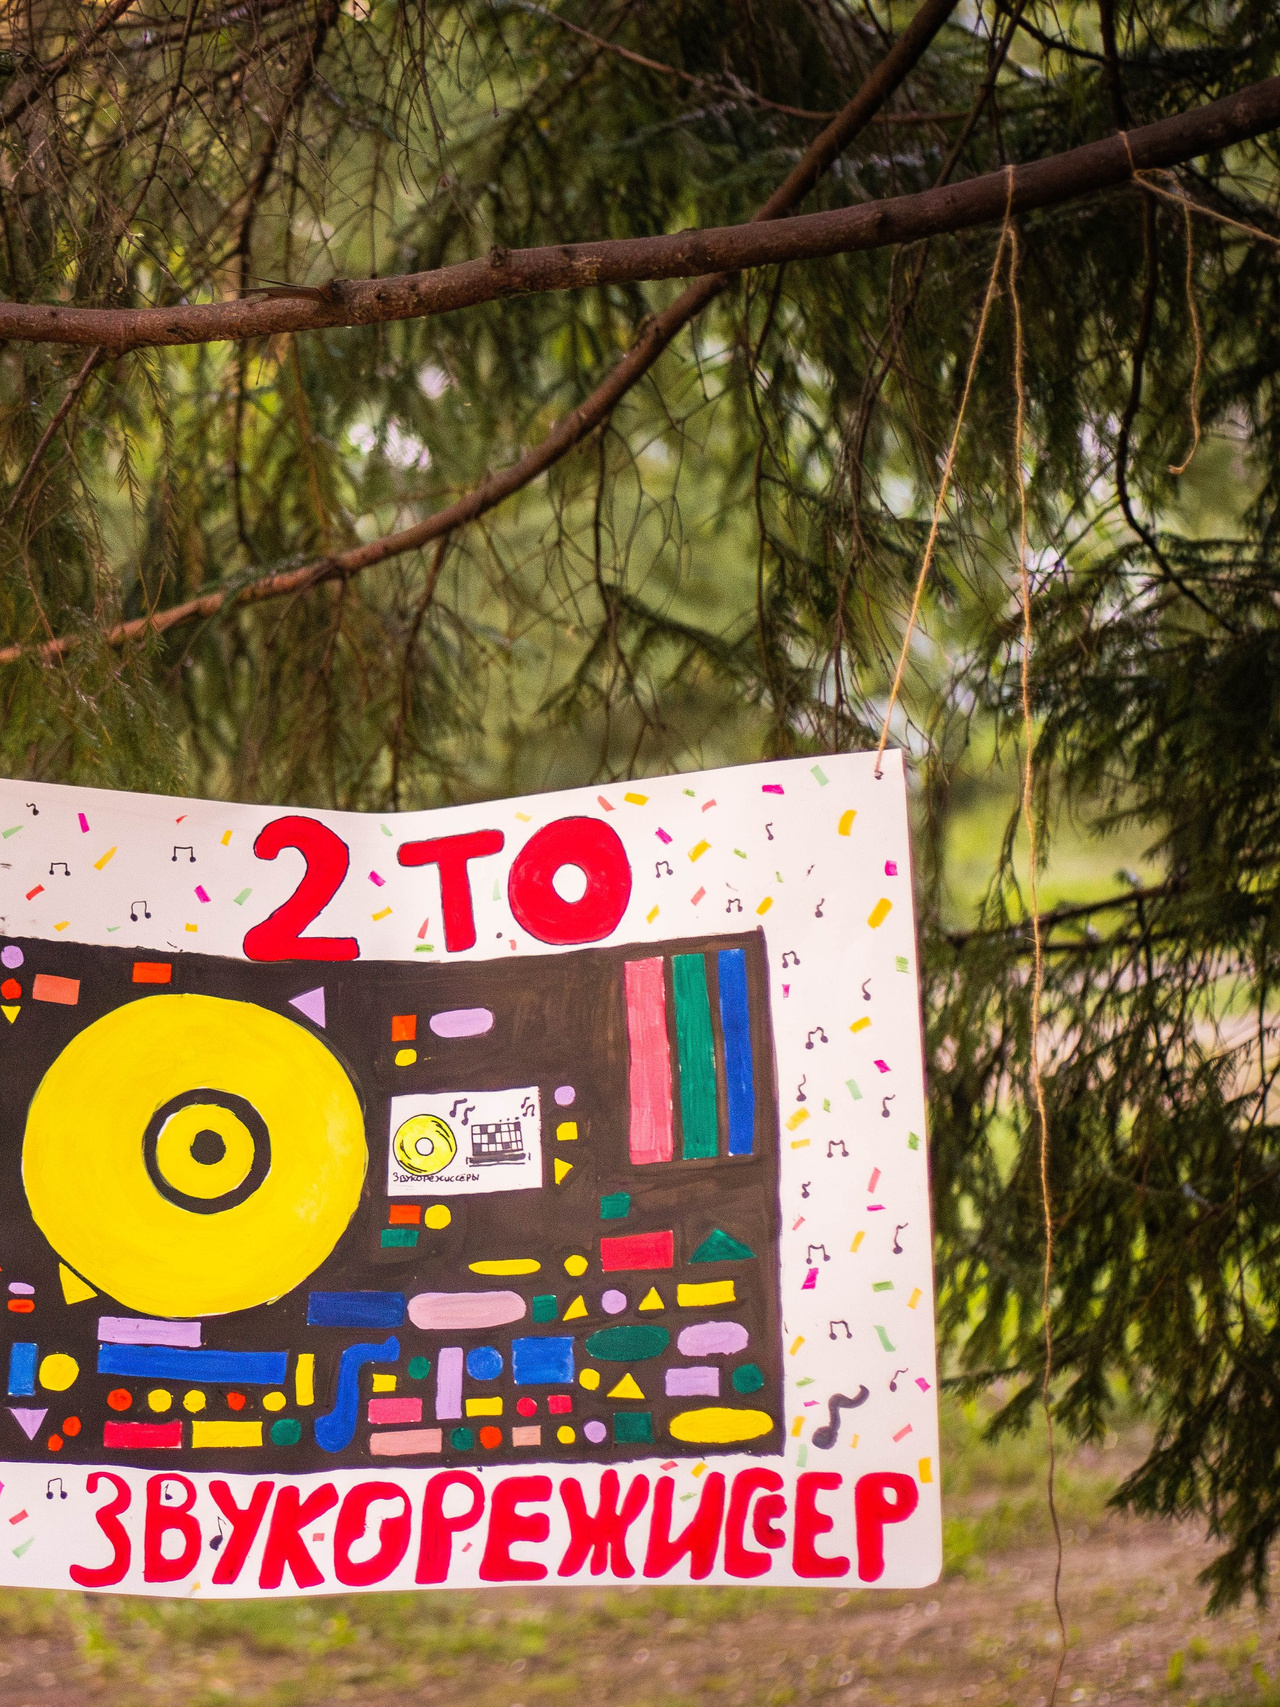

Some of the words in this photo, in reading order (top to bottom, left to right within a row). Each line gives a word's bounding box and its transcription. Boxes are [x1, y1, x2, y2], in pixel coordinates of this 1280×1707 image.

[242, 815, 361, 961] 2
[397, 815, 632, 952] ТО
[68, 1467, 920, 1590] ЗВУКОРЕЖИССЕР
